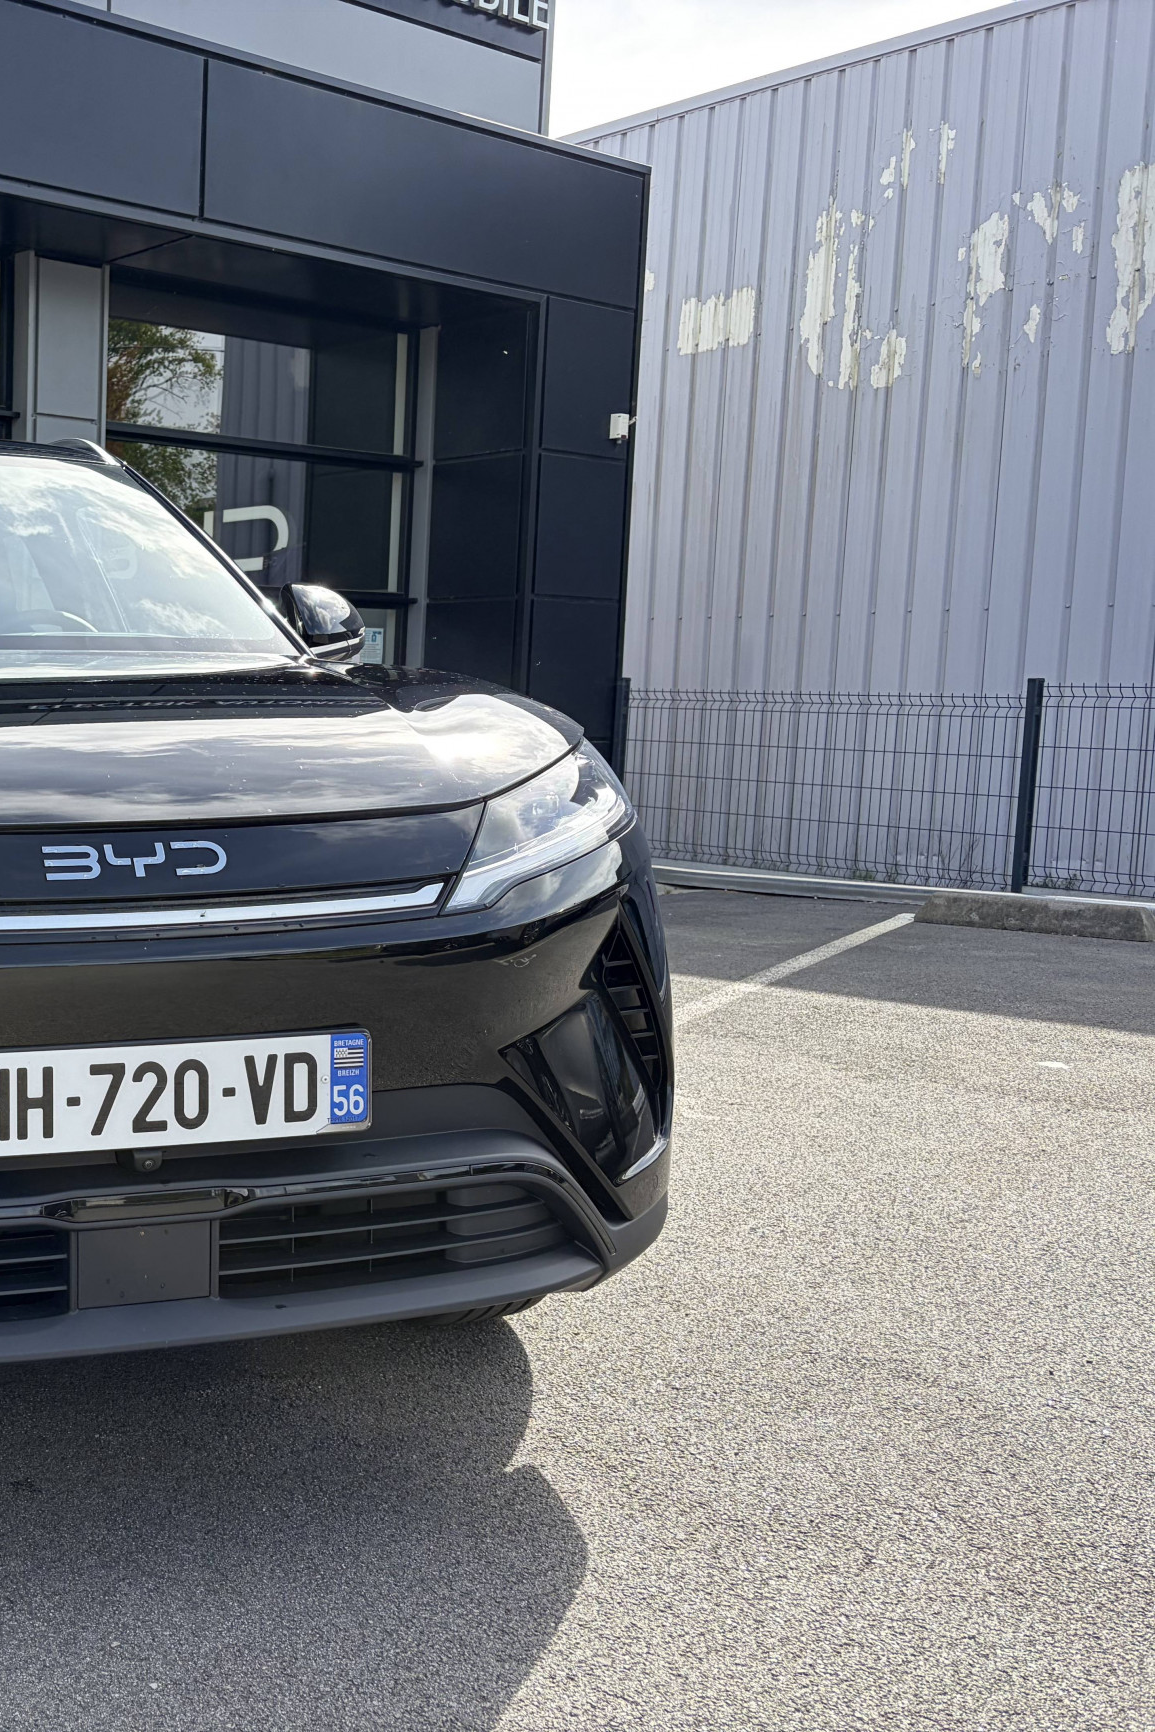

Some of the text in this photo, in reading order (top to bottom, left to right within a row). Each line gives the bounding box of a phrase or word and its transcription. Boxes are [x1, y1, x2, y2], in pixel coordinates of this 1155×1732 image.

[41, 840, 228, 881] BYD
[333, 1038, 365, 1047] BRETAGNE
[337, 1069, 360, 1077] BREIZH
[333, 1083, 365, 1117] 56
